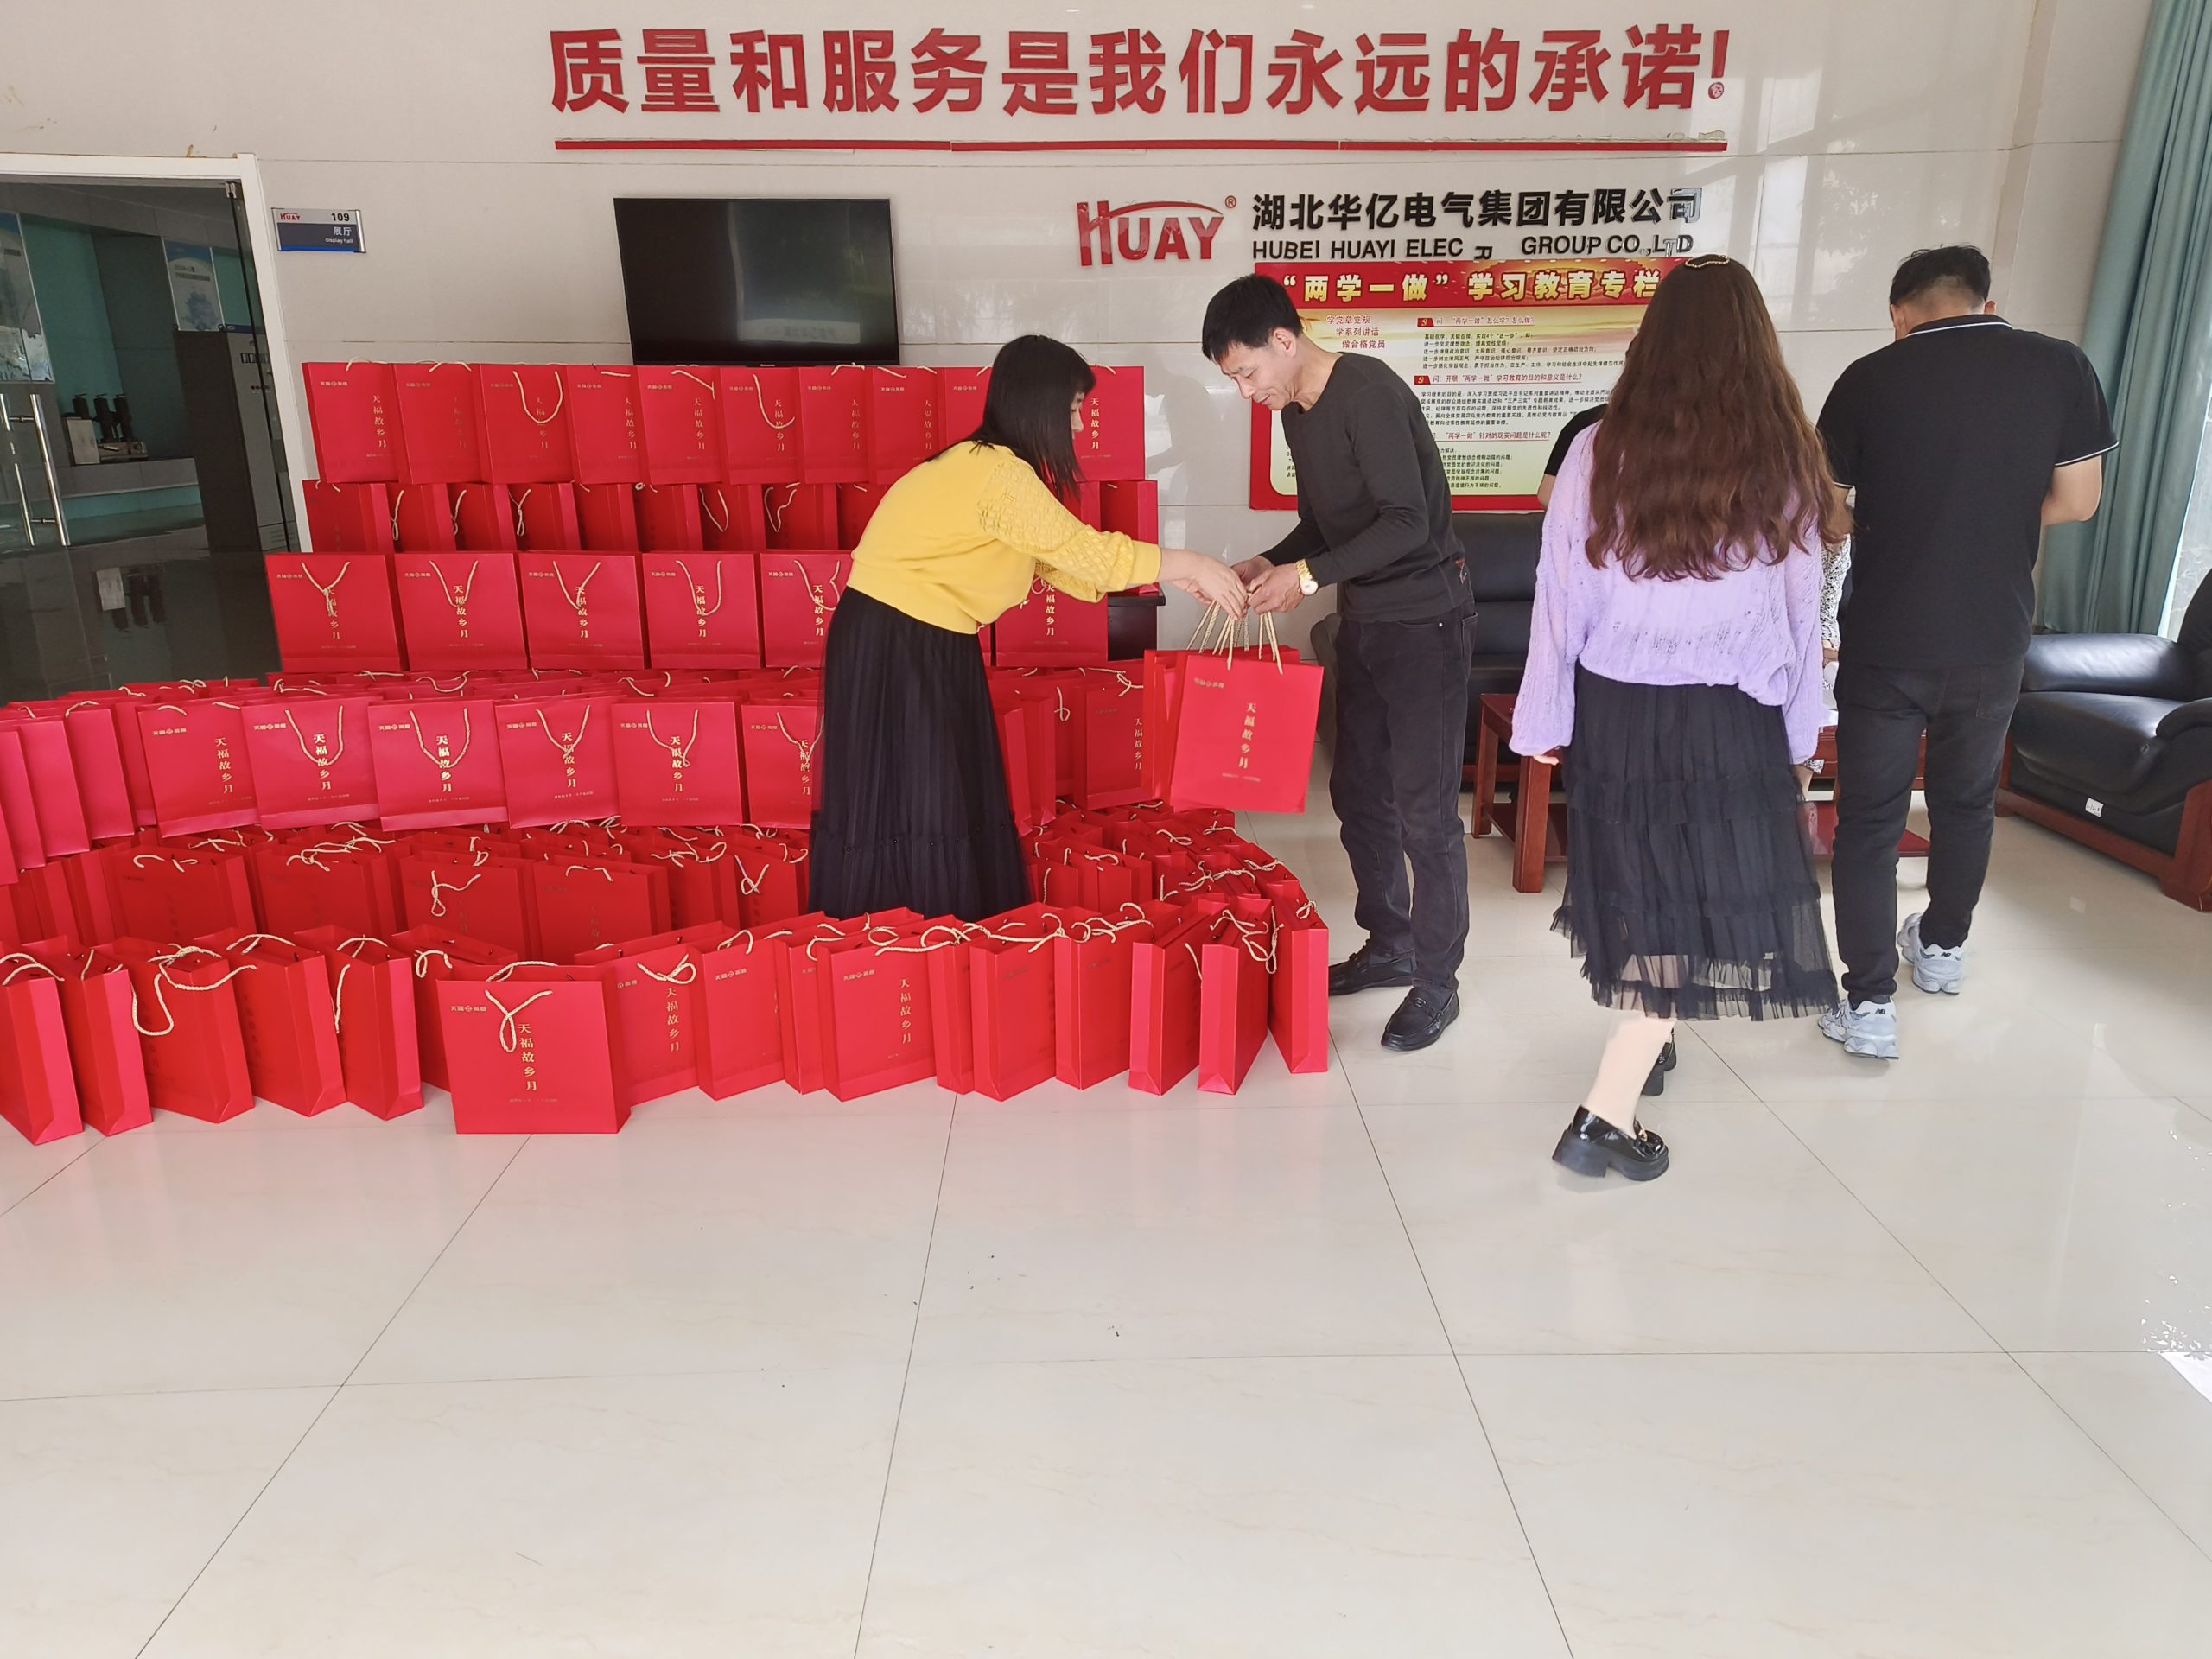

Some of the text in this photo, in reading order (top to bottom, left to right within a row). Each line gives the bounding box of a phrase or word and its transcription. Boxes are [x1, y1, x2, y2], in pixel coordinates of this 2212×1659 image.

[549, 23, 1729, 116] 质量和服务是我们永远的承诺!
[331, 213, 350, 222] 109
[333, 226, 352, 236] 展厅
[1251, 186, 1703, 231] 湖北华亿电气集团有限公司
[1252, 239, 1320, 260] HUBEI
[1330, 238, 1395, 259] HUAYI
[1521, 234, 1602, 256] GROUP
[372, 394, 387, 448] 天福故乡月
[693, 397, 706, 450] 天福故乡月
[1090, 397, 1100, 451] 天福故乡月
[1045, 582, 1056, 637] 天福故乡月
[1134, 716, 1144, 772] 天福故乡月
[1237, 701, 1258, 769] 天福故乡月
[213, 736, 234, 795] 天福故乡月
[664, 987, 680, 1053] 天福故乡月
[899, 977, 912, 1045] 天福故乡月
[518, 1022, 538, 1092] 天福故乡月
